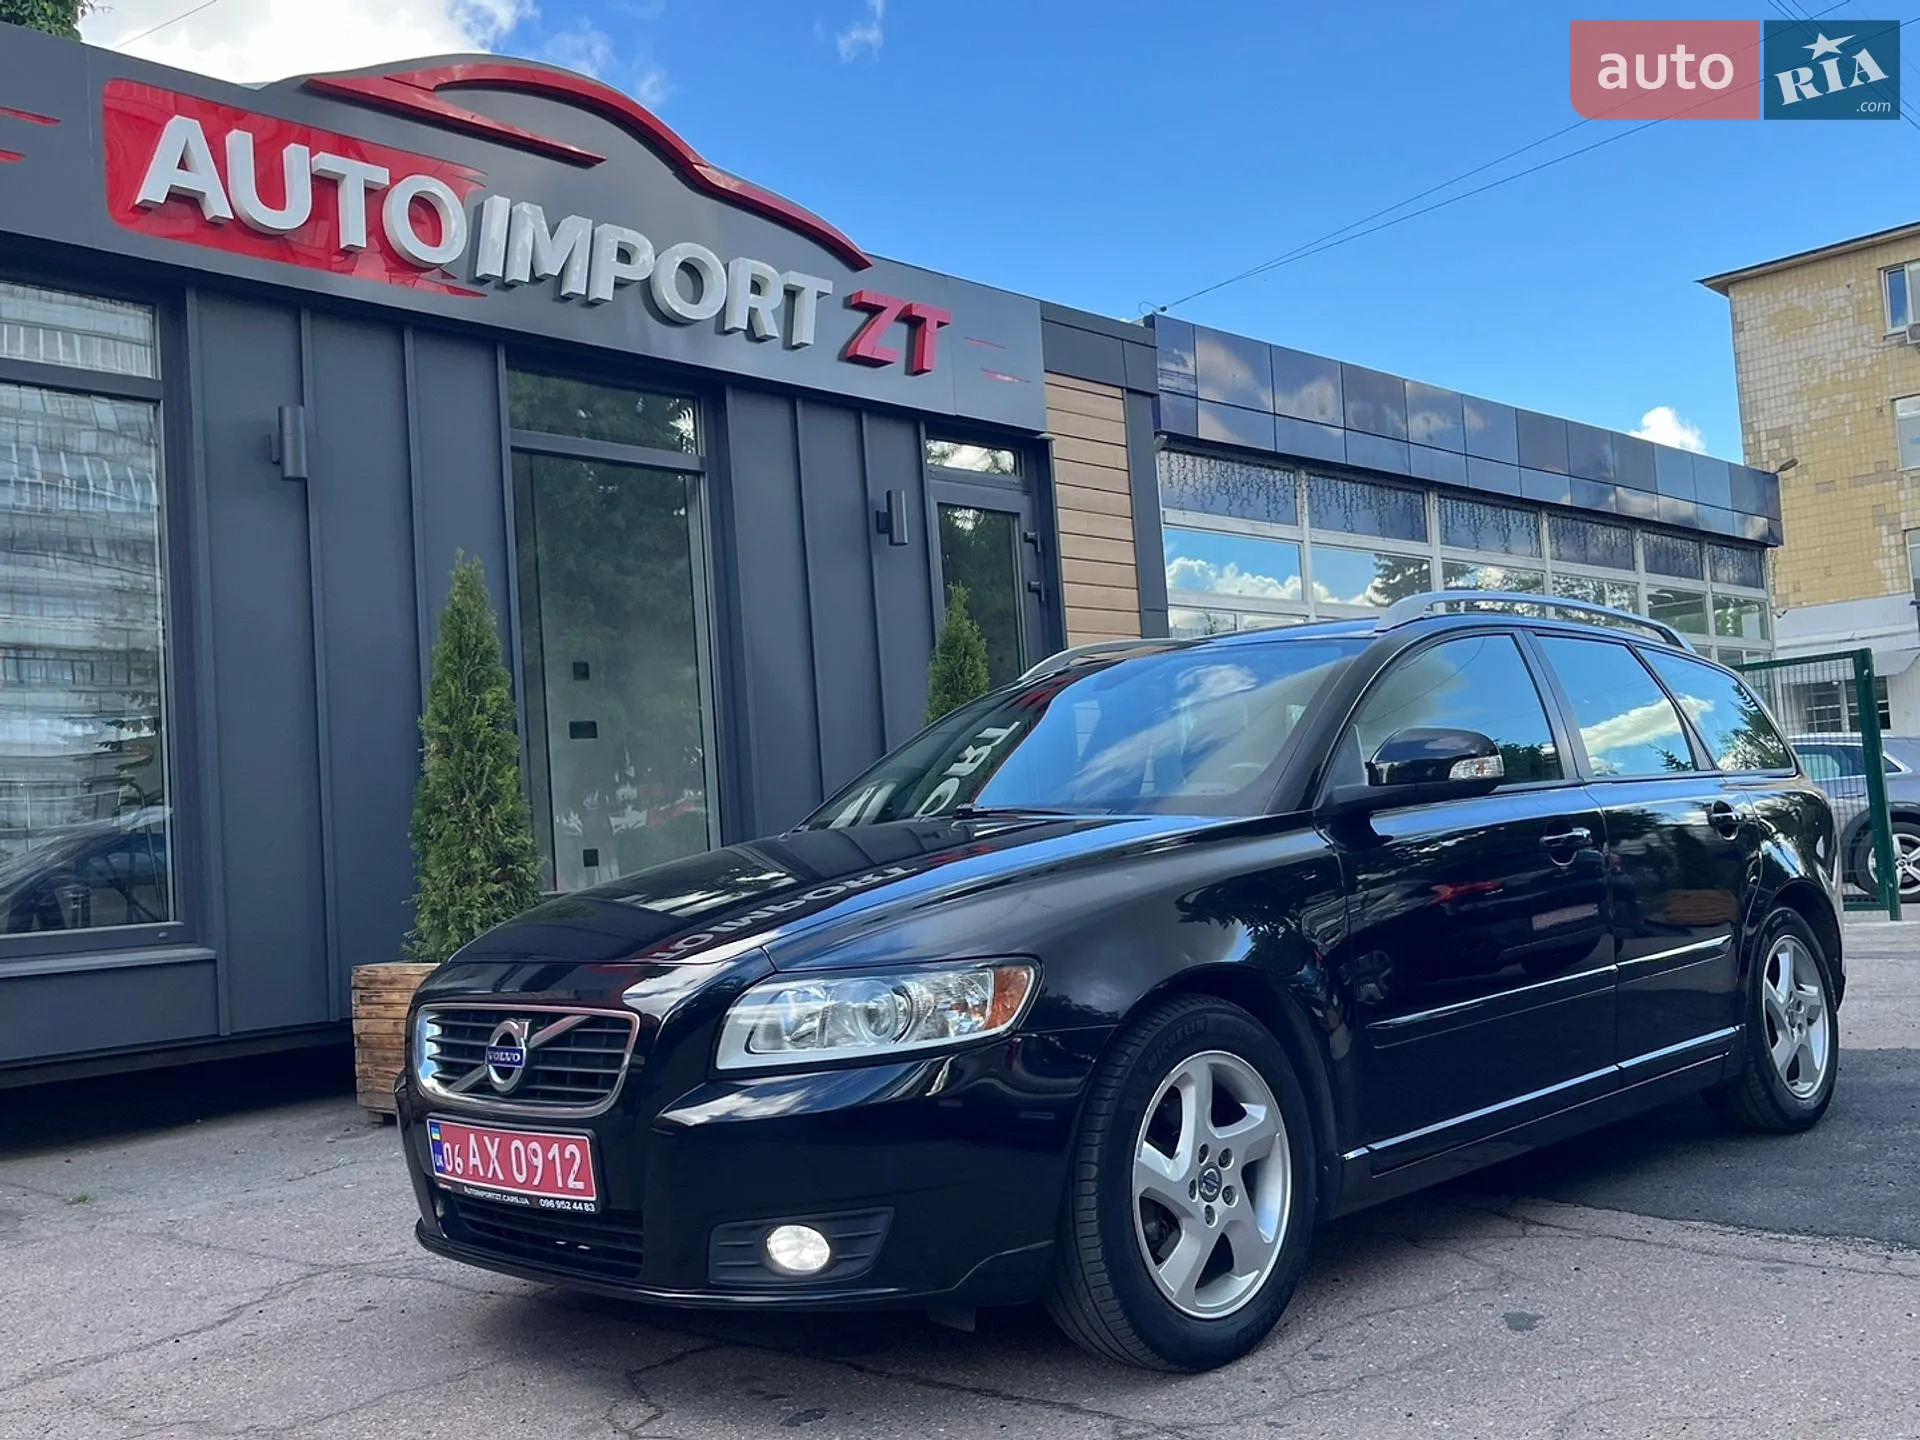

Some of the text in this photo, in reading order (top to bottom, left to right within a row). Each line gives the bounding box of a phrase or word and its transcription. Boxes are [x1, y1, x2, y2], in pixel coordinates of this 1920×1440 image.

[846, 289, 952, 376] ZT
[486, 1051, 521, 1063] VOLVO
[443, 1132, 585, 1190] 06 AX 0912
